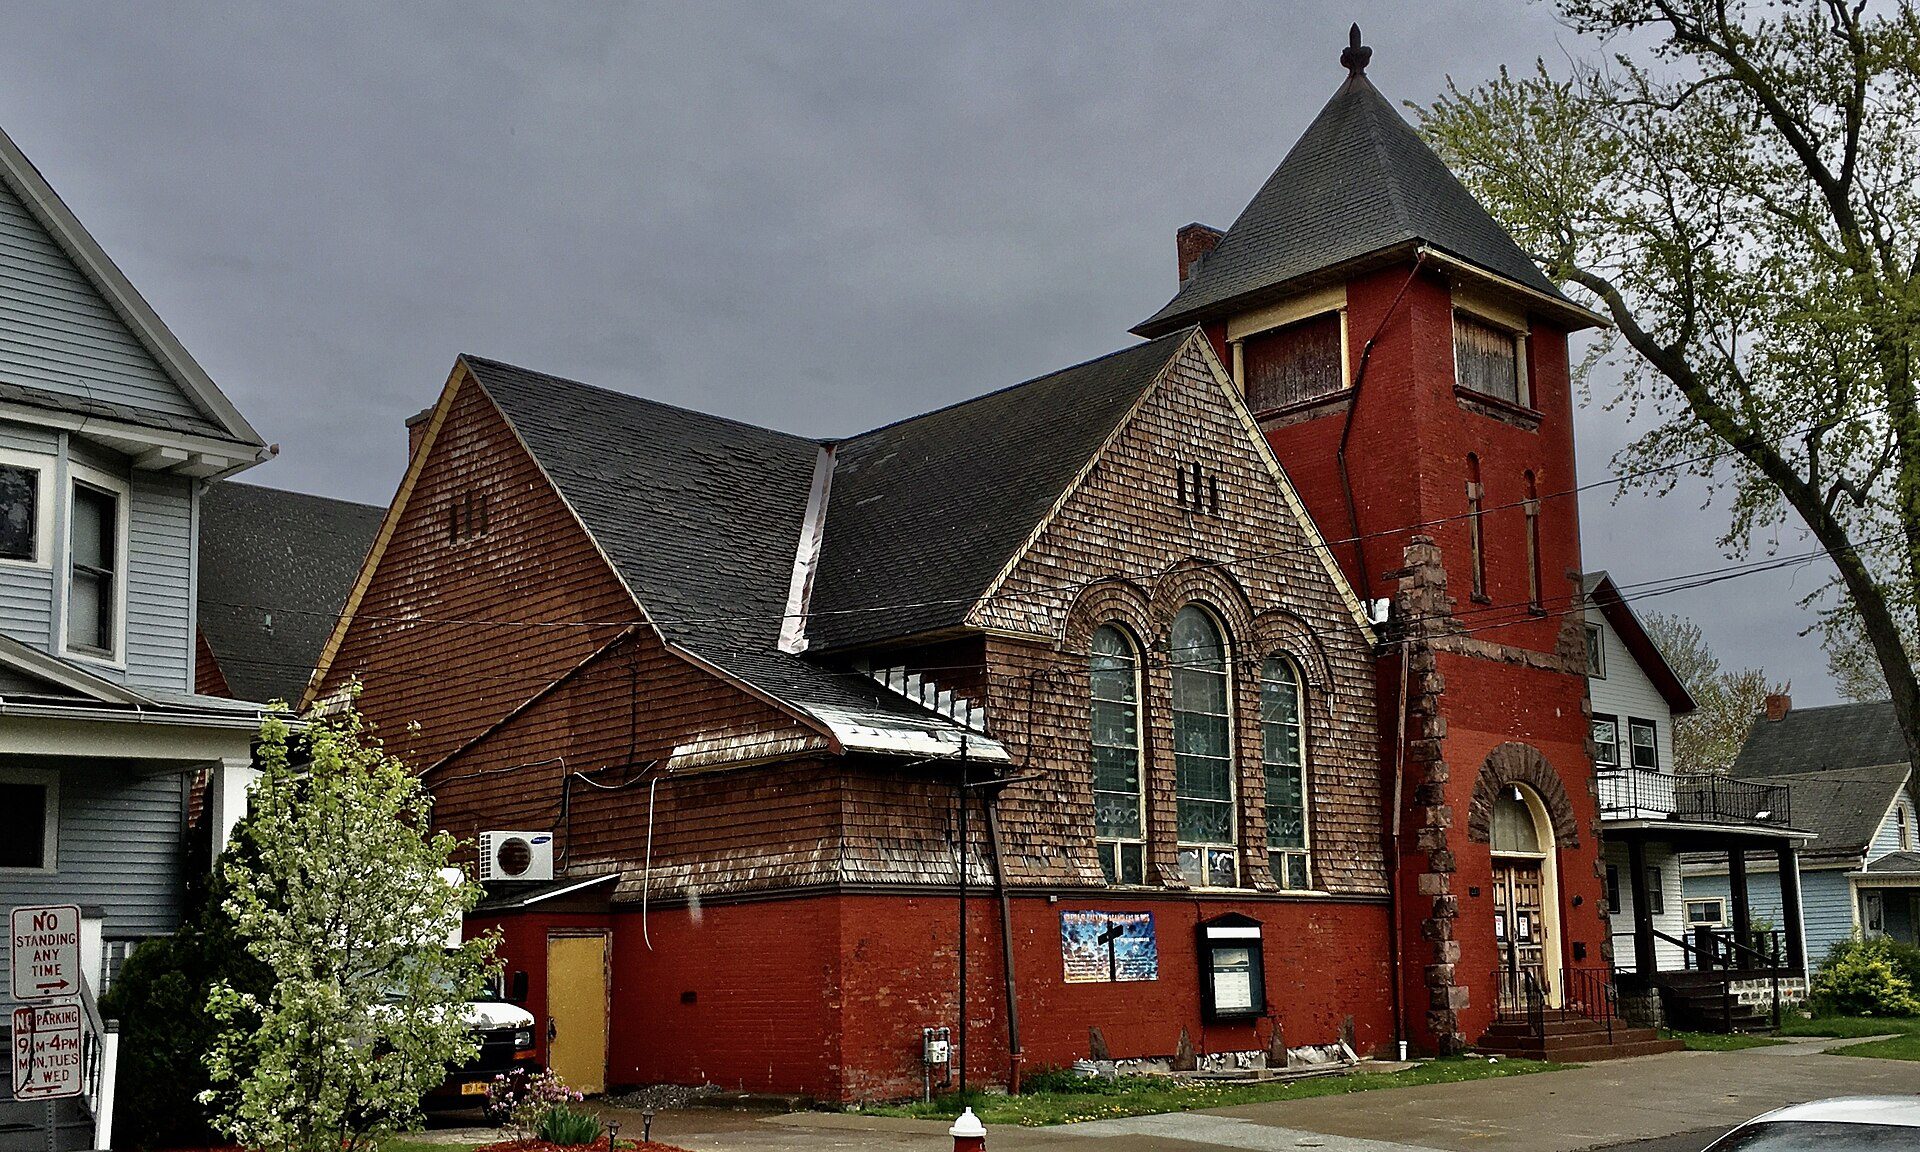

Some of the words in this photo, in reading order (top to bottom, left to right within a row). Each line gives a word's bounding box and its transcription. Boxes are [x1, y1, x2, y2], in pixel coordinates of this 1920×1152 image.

[33, 913, 58, 931] NO
[16, 933, 76, 948] STANDING
[33, 948, 60, 962] ANY
[32, 964, 62, 977] TIME
[36, 1011, 77, 1026] PARKING
[43, 1069, 70, 1083] WED
